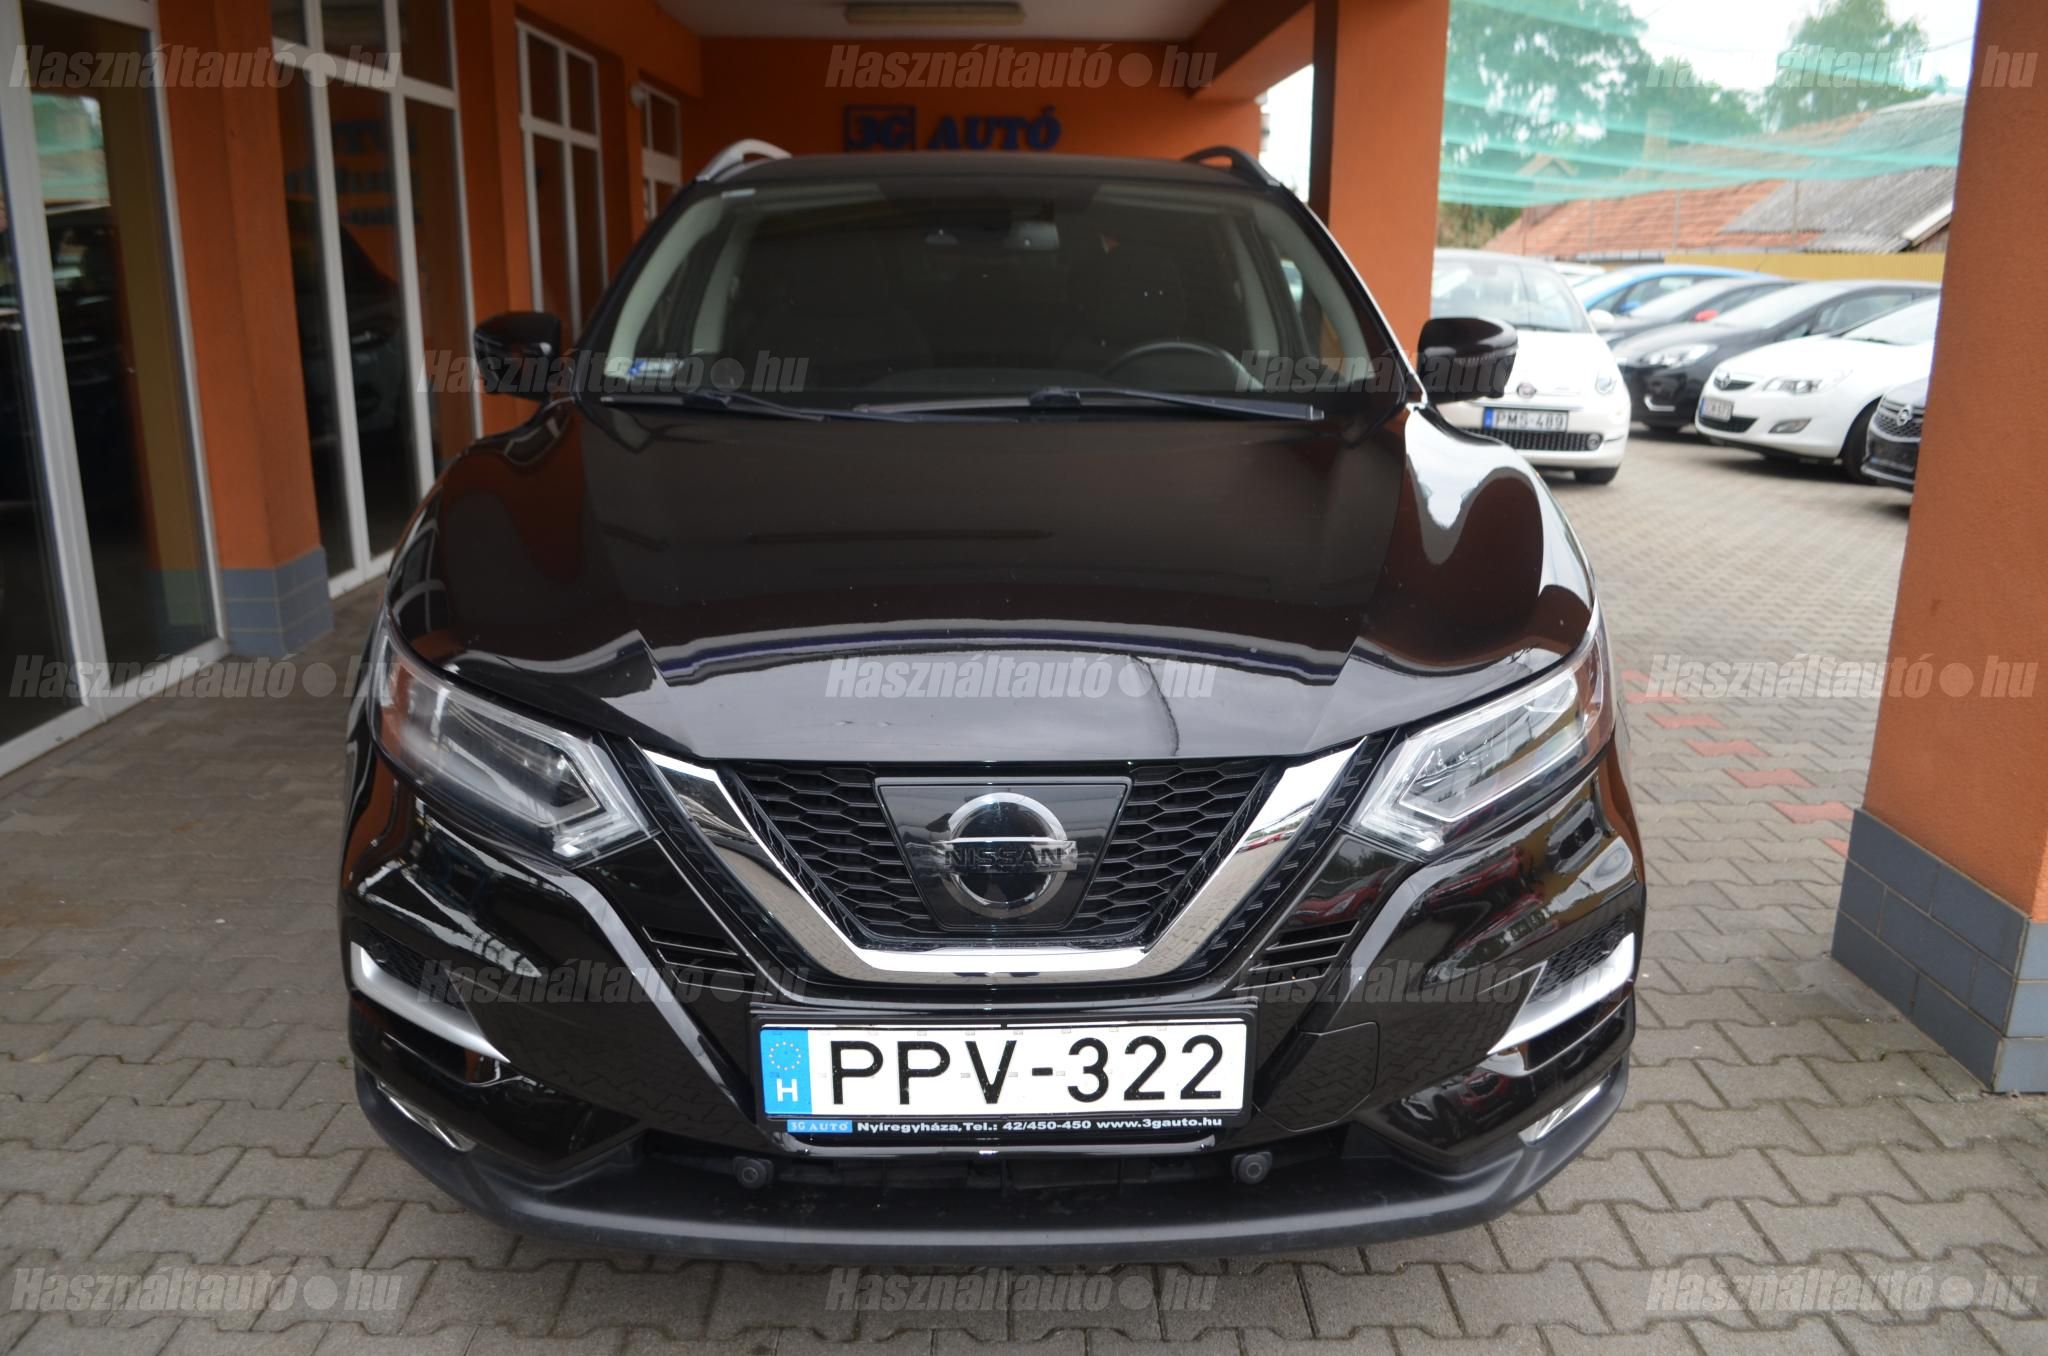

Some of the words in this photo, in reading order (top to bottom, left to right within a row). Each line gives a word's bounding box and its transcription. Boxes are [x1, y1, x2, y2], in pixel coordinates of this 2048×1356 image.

[944, 847, 1063, 869] NISSAN
[830, 1034, 1223, 1105] PPV-322
[776, 1079, 798, 1102] H
[791, 1121, 805, 1131] 3G
[1002, 1119, 1092, 1131] 42/450-450
[1096, 1117, 1223, 1129] www.3gauto.hu
